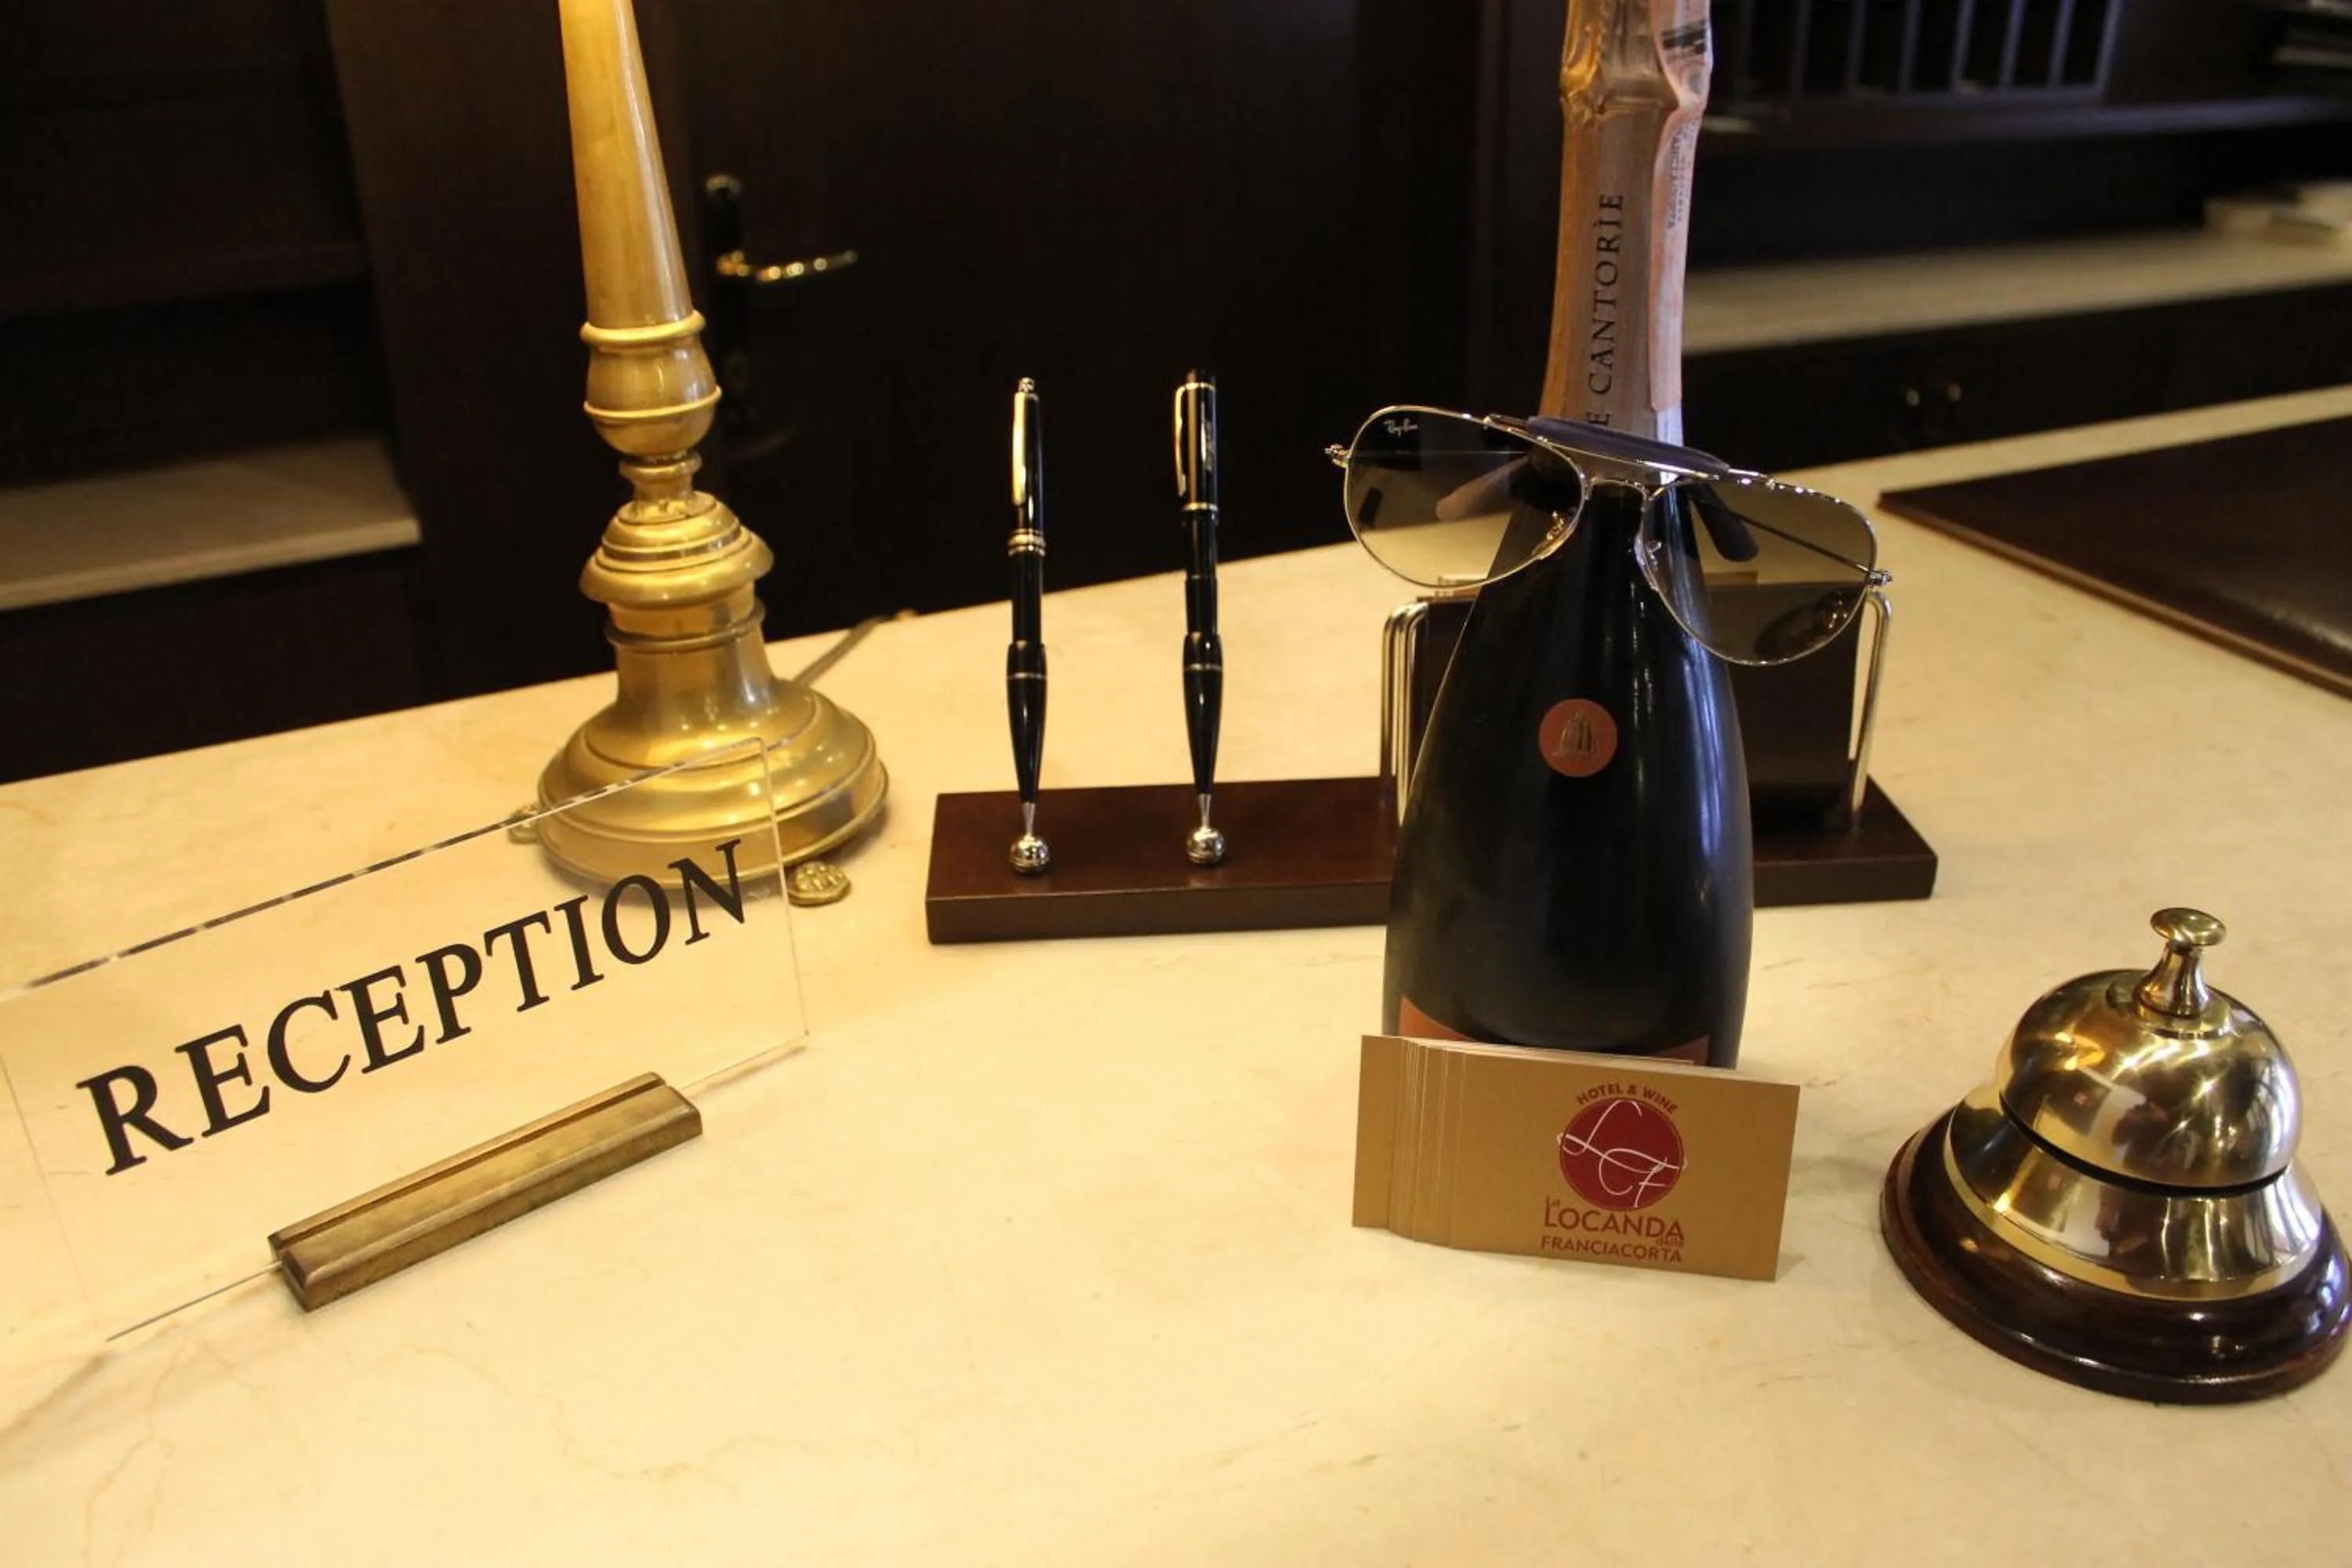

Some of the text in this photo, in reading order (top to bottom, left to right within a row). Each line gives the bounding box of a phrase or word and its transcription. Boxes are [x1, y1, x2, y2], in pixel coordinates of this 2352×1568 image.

[1586, 412, 1610, 426] E
[76, 838, 750, 1175] RECEPTION
[1575, 1083, 1679, 1115] HOTEL & WINE
[1544, 1204, 1685, 1240] LOCANDA
[1541, 1235, 1682, 1262] FRANCIACORTA
